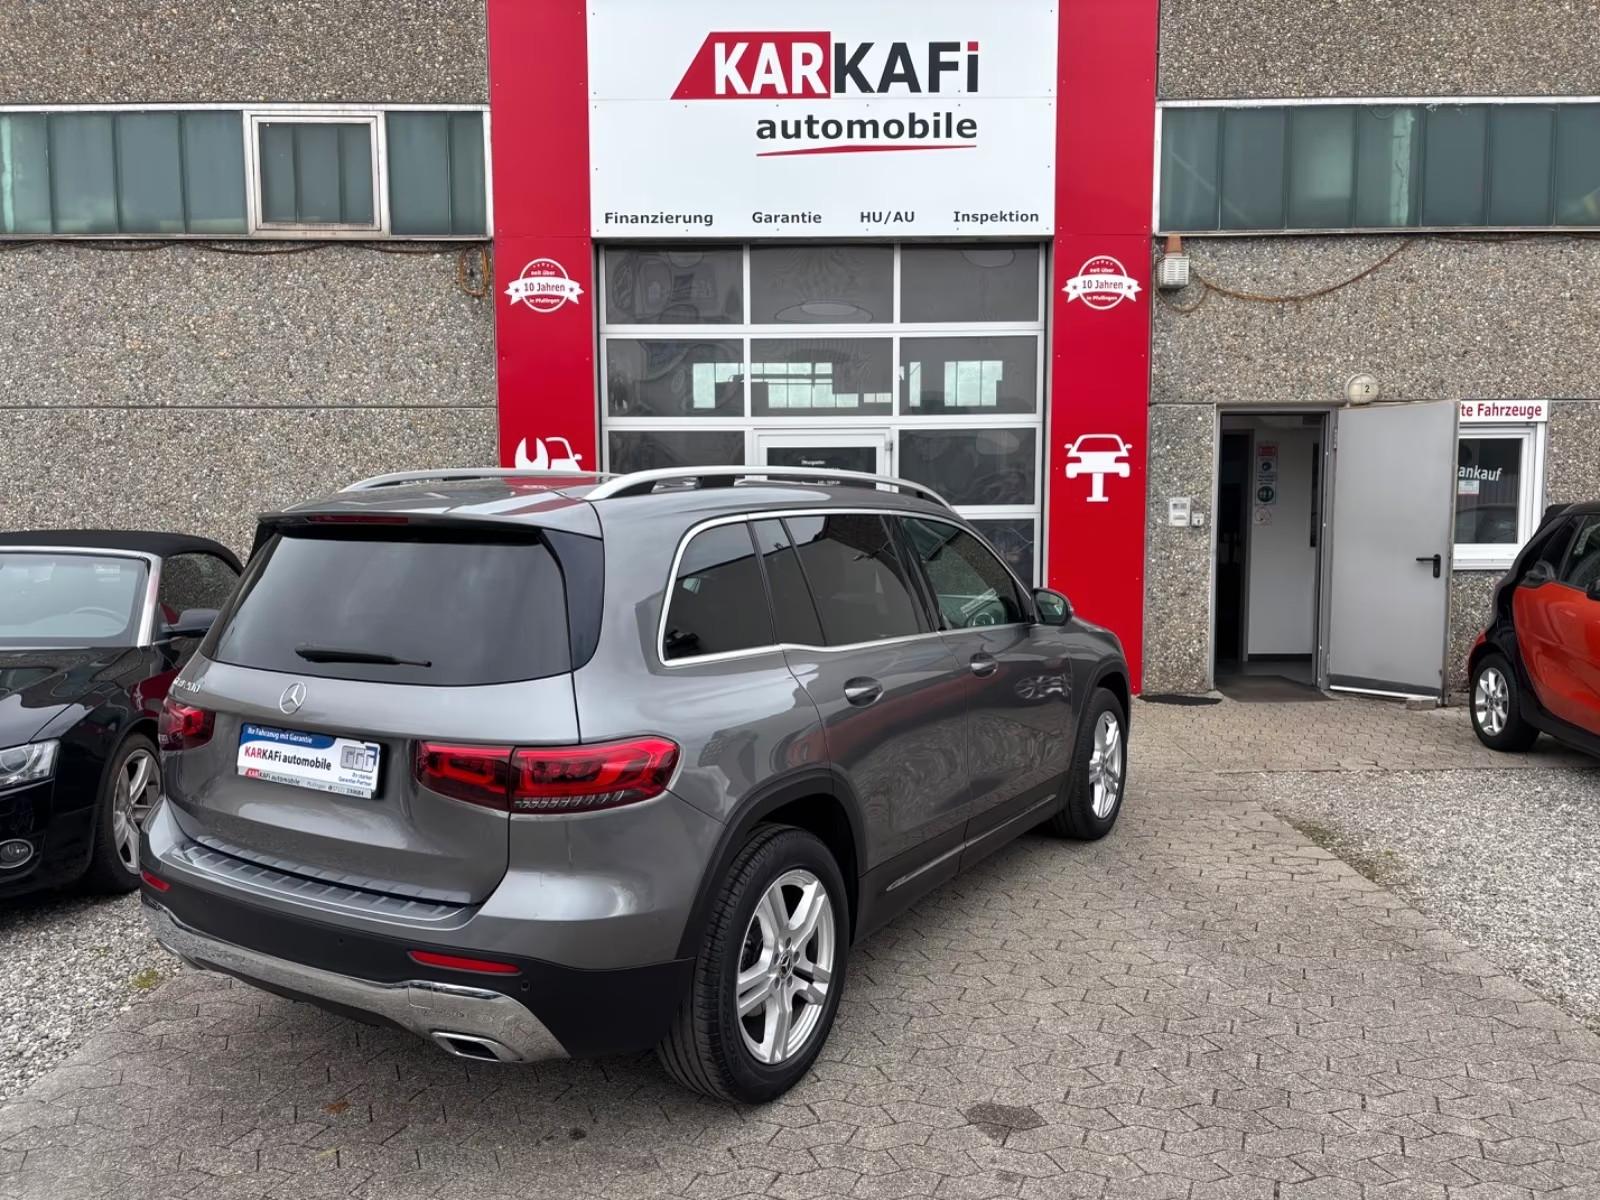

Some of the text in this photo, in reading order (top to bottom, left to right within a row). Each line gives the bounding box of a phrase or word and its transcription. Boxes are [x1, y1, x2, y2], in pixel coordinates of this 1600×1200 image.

[713, 41, 979, 95] KARKAFi
[756, 112, 978, 140] automobile
[604, 210, 1039, 227] Finanzierung Garantie HU/AU Inspektion
[524, 282, 566, 292] 10 Jahren
[1082, 279, 1124, 289] 10 Jahren
[1364, 384, 1370, 393] 2
[1460, 402, 1542, 419] te Fahrzeuge
[289, 732, 313, 744] Garantie
[244, 745, 332, 771] KARKAFi automobile
